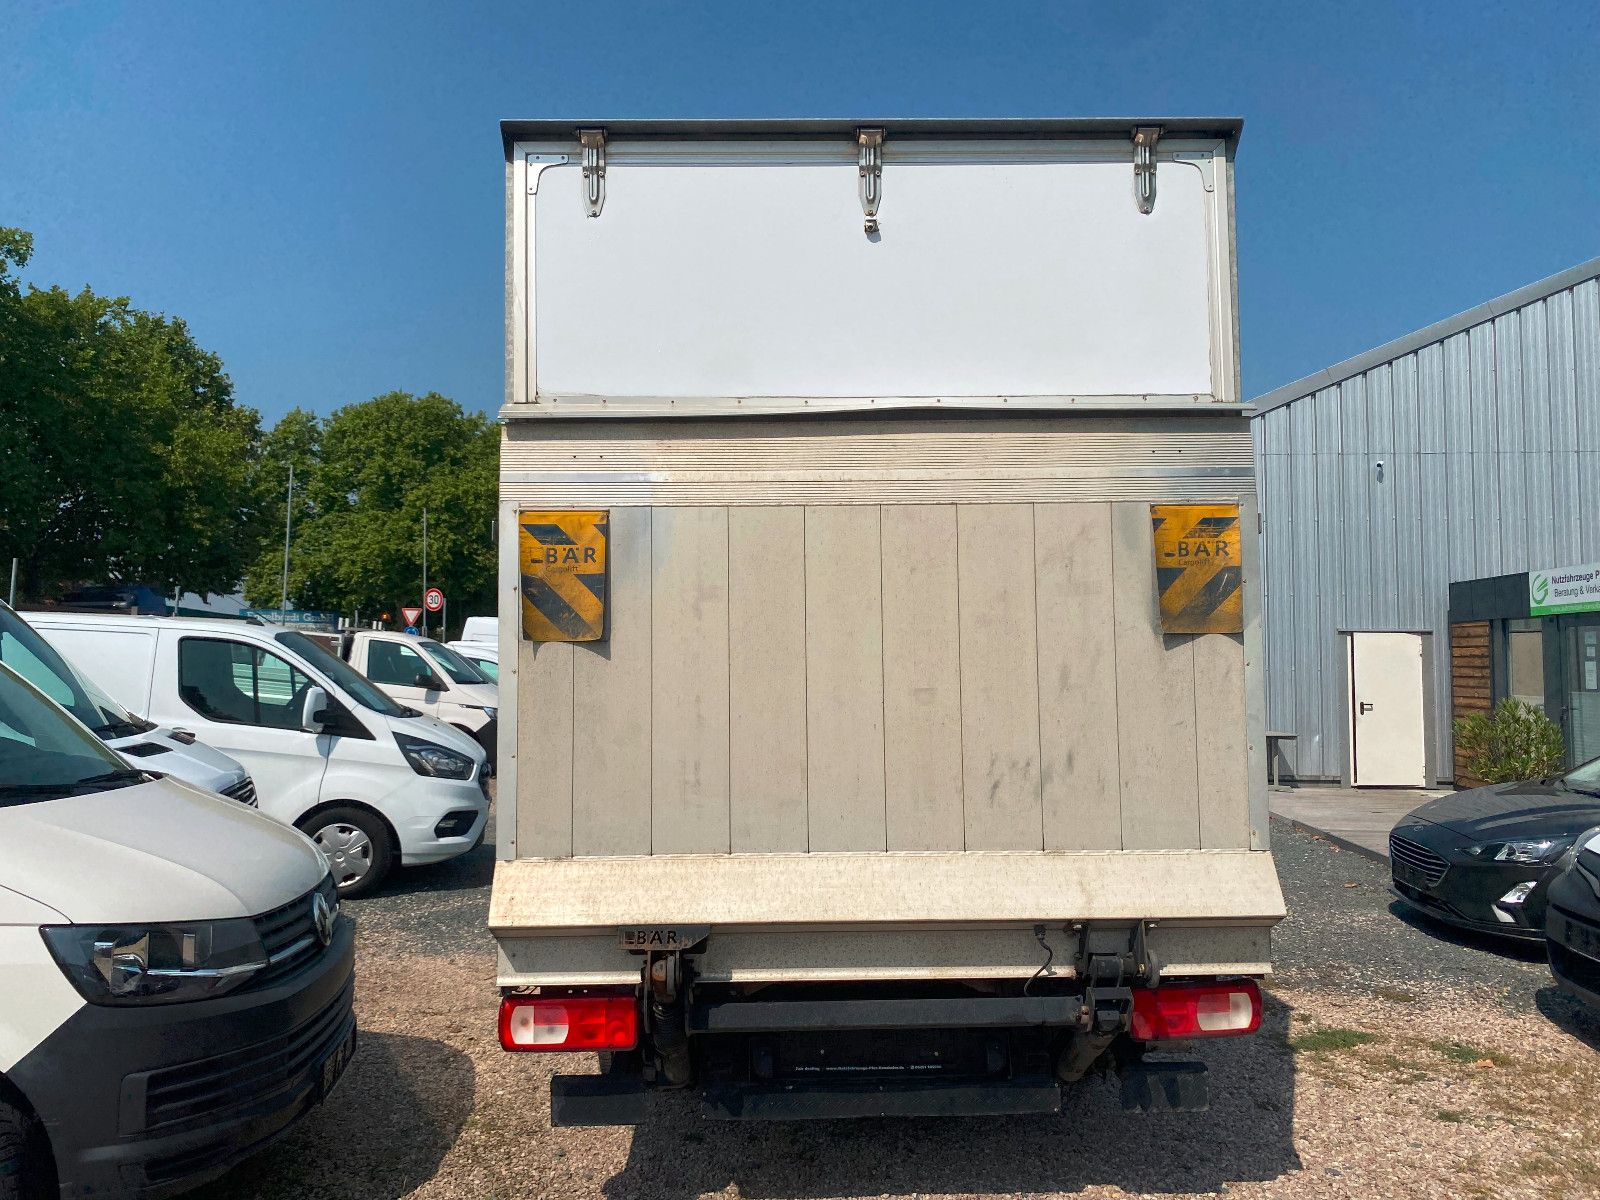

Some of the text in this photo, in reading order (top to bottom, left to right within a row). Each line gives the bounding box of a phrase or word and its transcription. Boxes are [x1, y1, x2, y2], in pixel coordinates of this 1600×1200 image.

[546, 547, 597, 563] BÄR
[1551, 573, 1594, 585] Nutzfahrzeuge
[1554, 588, 1579, 597] Beratung
[1580, 586, 1585, 595] &
[429, 594, 440, 605] 30
[637, 930, 678, 945] BÄR
